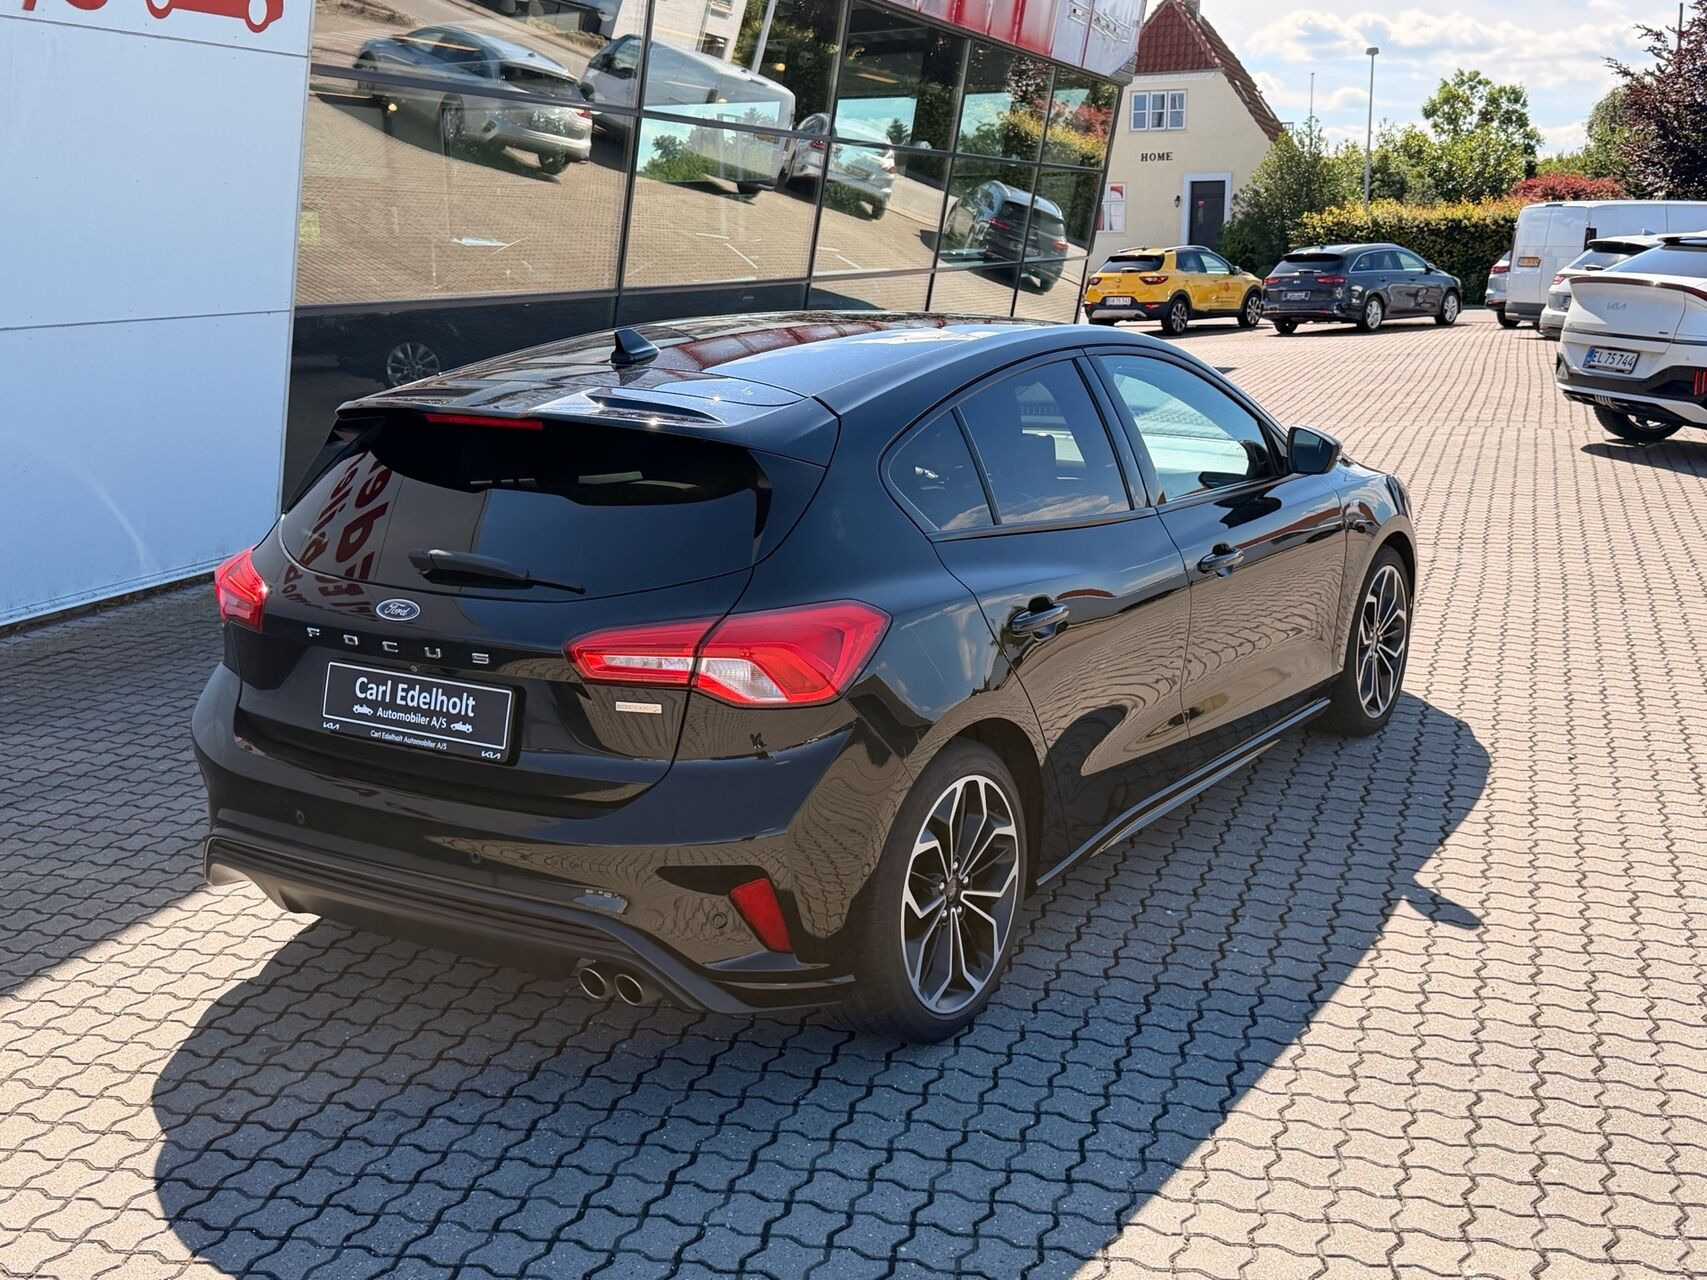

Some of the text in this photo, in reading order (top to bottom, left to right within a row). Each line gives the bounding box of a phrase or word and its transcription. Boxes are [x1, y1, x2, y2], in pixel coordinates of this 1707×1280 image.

[1140, 151, 1174, 162] HOME
[384, 602, 409, 617] Ford
[306, 626, 490, 665] FOCUS
[354, 676, 476, 717] Carl Edelholt
[376, 706, 447, 729] Automobiler A/S
[370, 729, 448, 750] Carl Edelholt Automobiler A/S
